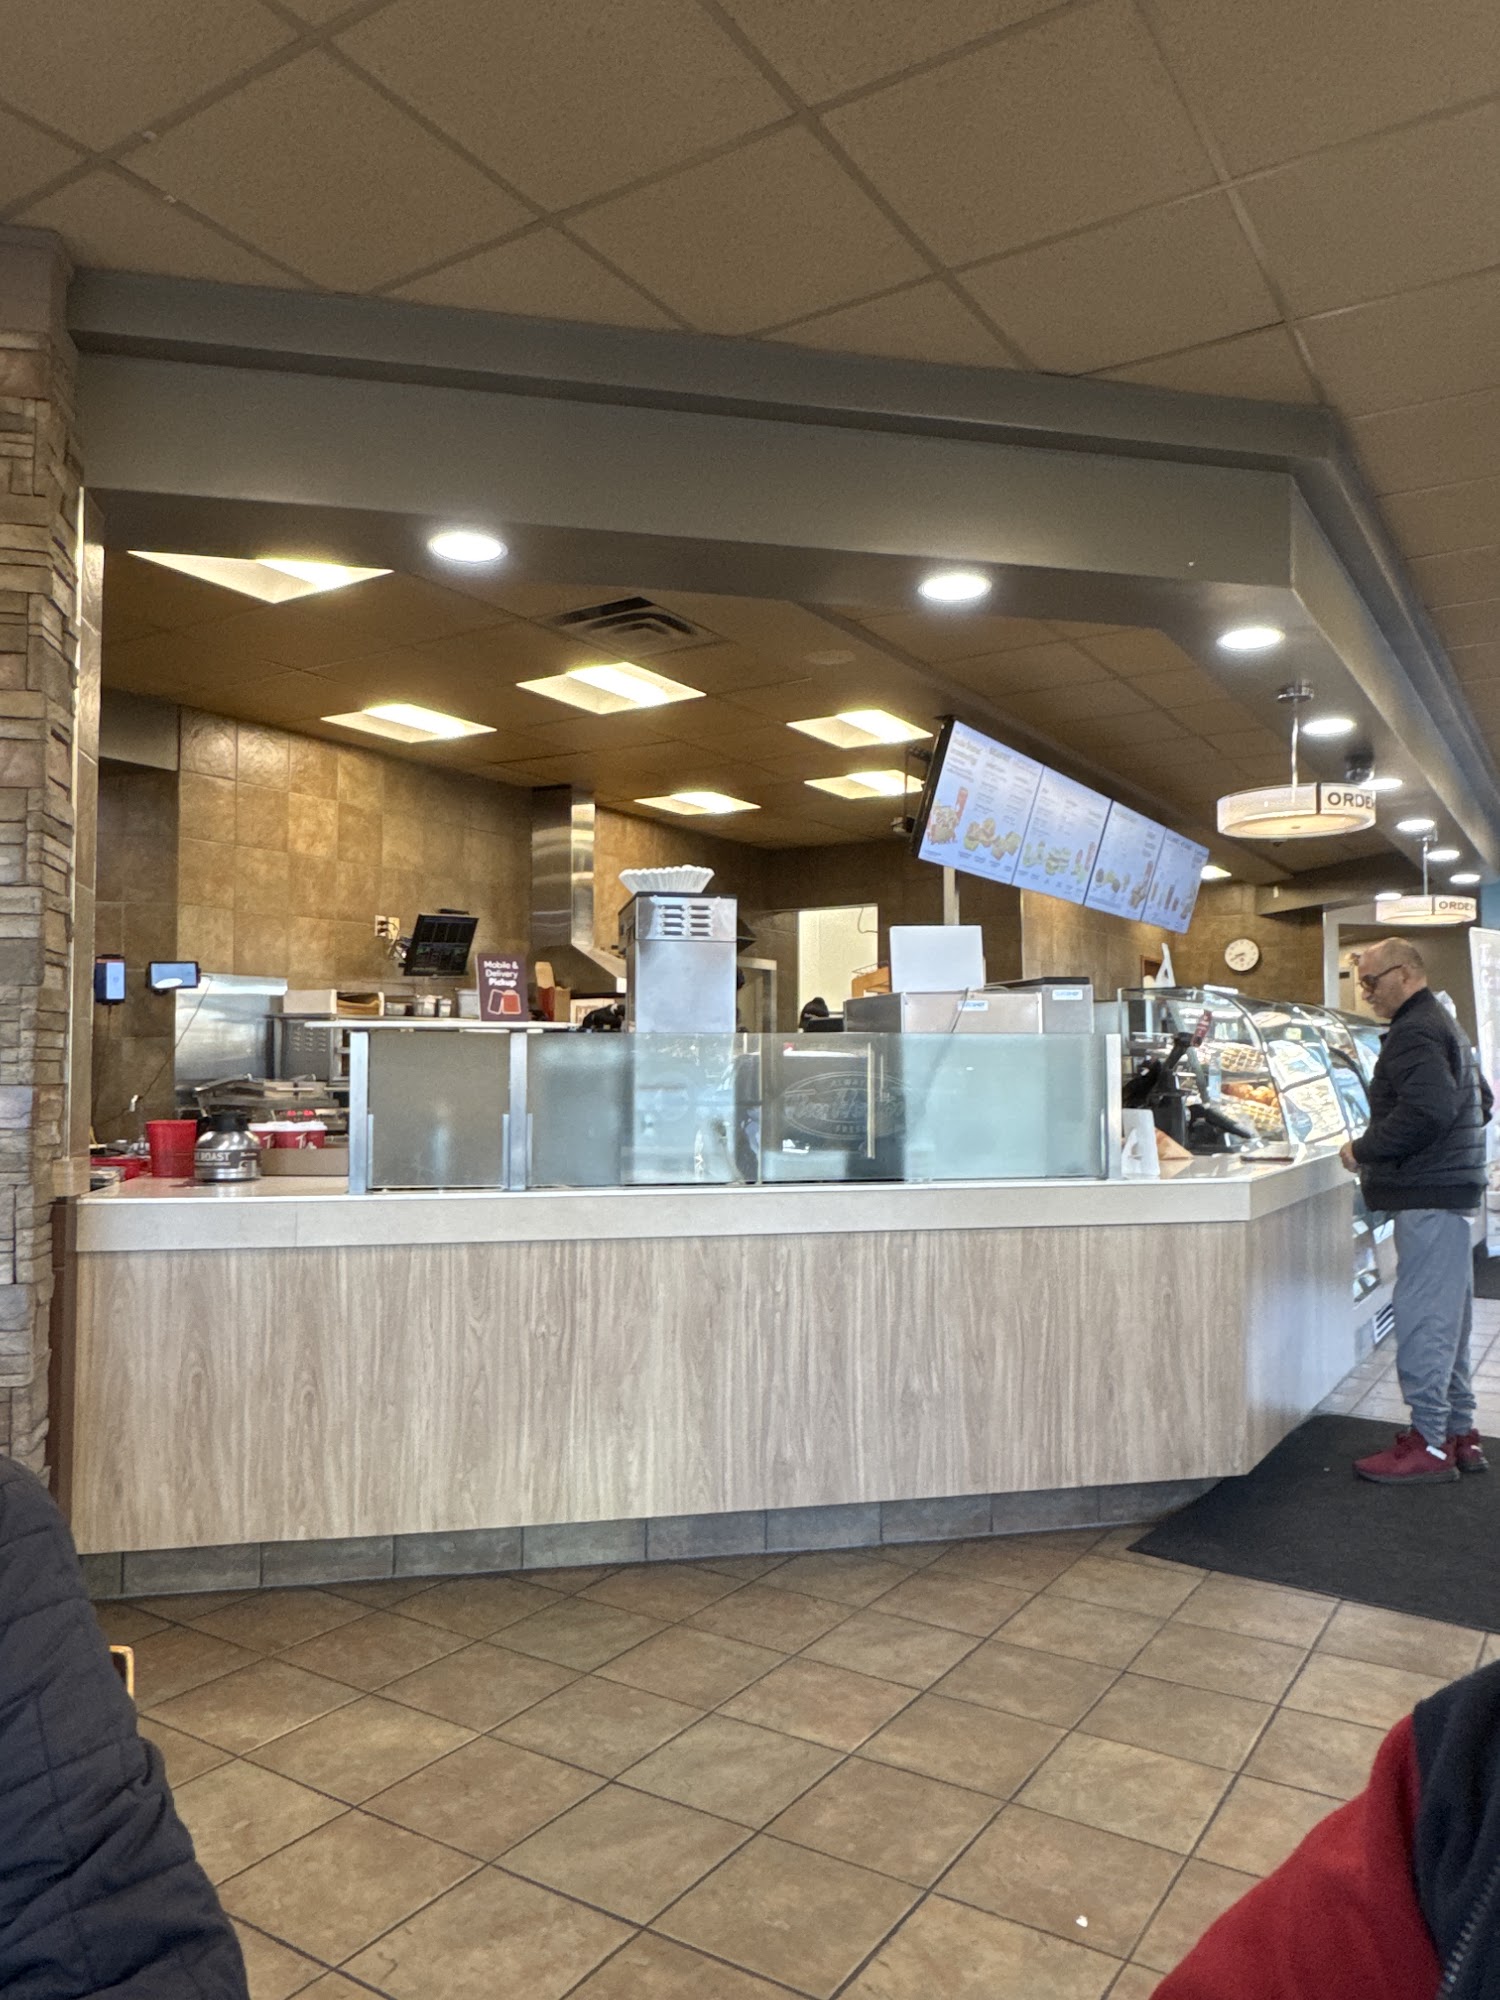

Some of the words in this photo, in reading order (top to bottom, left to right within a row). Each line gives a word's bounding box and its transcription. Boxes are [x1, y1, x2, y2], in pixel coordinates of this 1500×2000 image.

[483, 961, 511, 969] Mobile
[512, 961, 519, 969] &
[485, 969, 519, 979] Delivery
[488, 978, 517, 988] Pickup
[831, 1078, 867, 1087] ALWAY
[835, 1124, 867, 1133] FRES
[200, 1151, 231, 1161] ROAST
